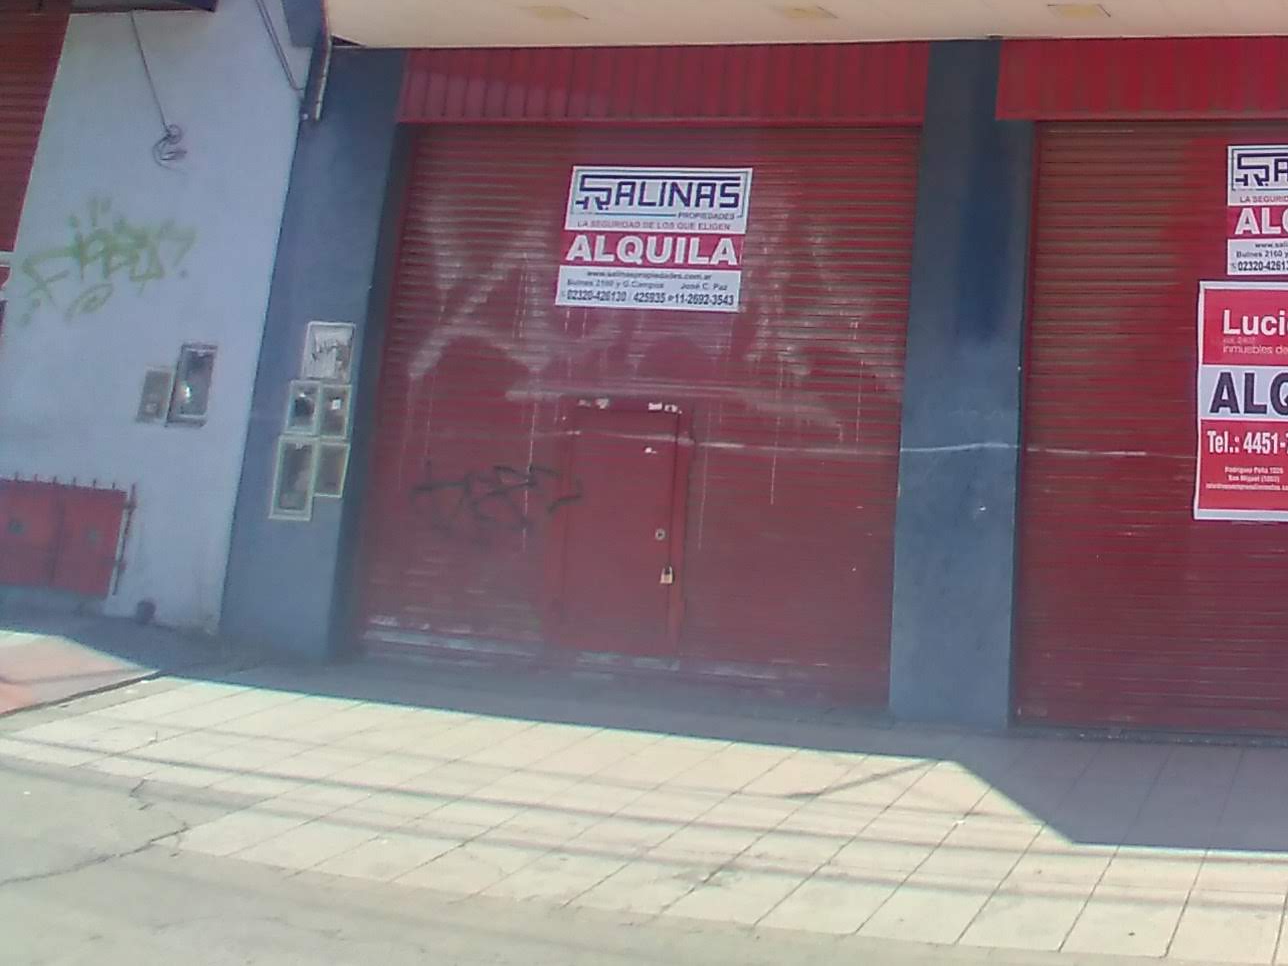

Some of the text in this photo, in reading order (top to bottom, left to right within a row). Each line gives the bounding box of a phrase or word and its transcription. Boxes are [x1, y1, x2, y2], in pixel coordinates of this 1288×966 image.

[575, 174, 742, 211] SALINAS
[565, 234, 738, 265] ALQUILA
[1207, 430, 1240, 454] Tel.:
